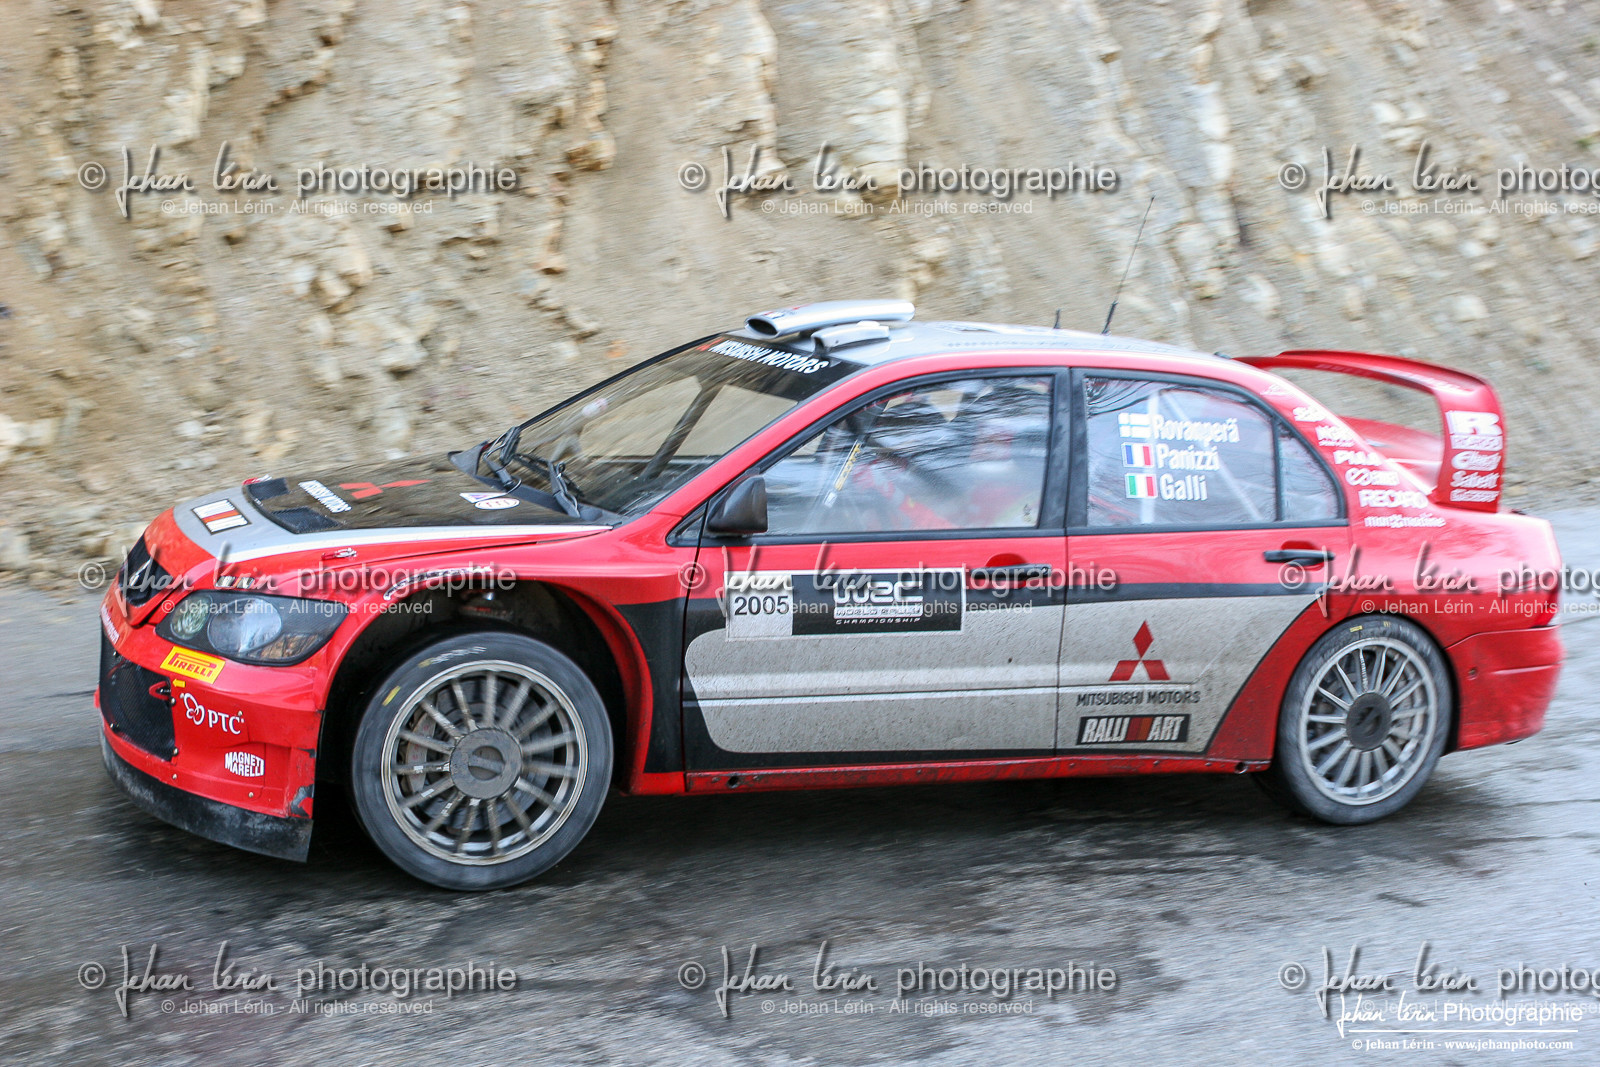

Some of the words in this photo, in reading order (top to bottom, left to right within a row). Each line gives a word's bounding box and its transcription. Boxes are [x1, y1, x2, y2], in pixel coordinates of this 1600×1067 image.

[1156, 443, 1220, 471] Panizzi
[1160, 473, 1208, 500] Galli
[735, 595, 790, 615] 2005
[836, 617, 921, 625] CHAMPIONSHIP
[168, 652, 217, 678] PIRELLI
[1076, 691, 1144, 706] MITSUBISHI
[1147, 690, 1201, 704] MOTORS
[208, 709, 242, 735] PTC
[225, 751, 265, 770] MAGNETI
[225, 760, 265, 777] MARELLI
